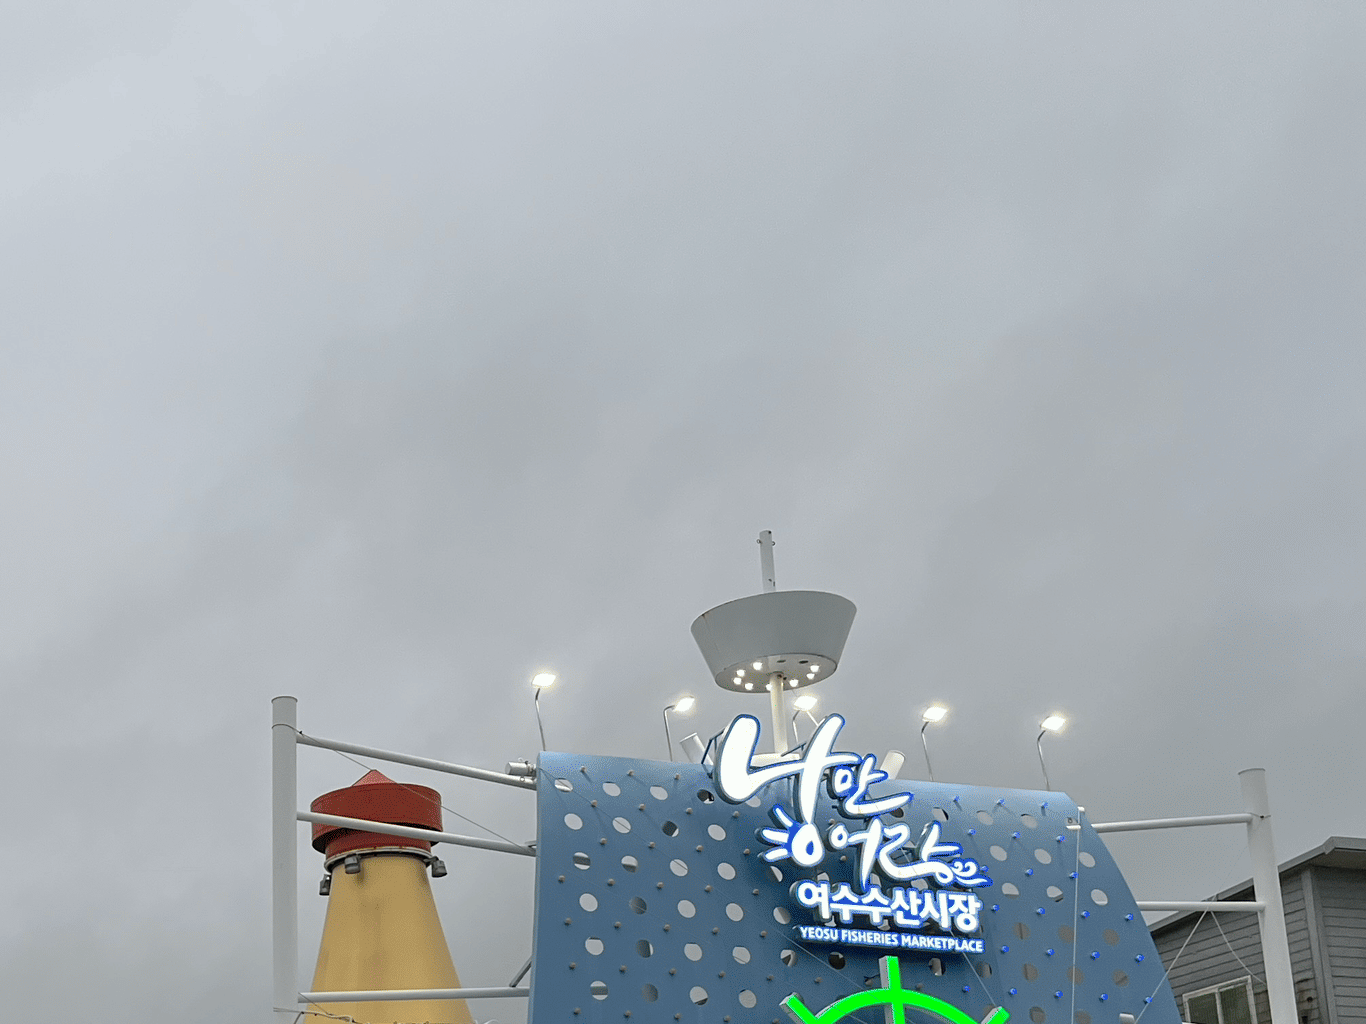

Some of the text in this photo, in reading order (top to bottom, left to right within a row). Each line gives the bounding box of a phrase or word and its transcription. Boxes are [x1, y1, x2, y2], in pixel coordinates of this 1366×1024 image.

[796, 881, 983, 932] 여수수산시장
[800, 926, 983, 952] YEOSU FISHERIES MARKETPLACE
